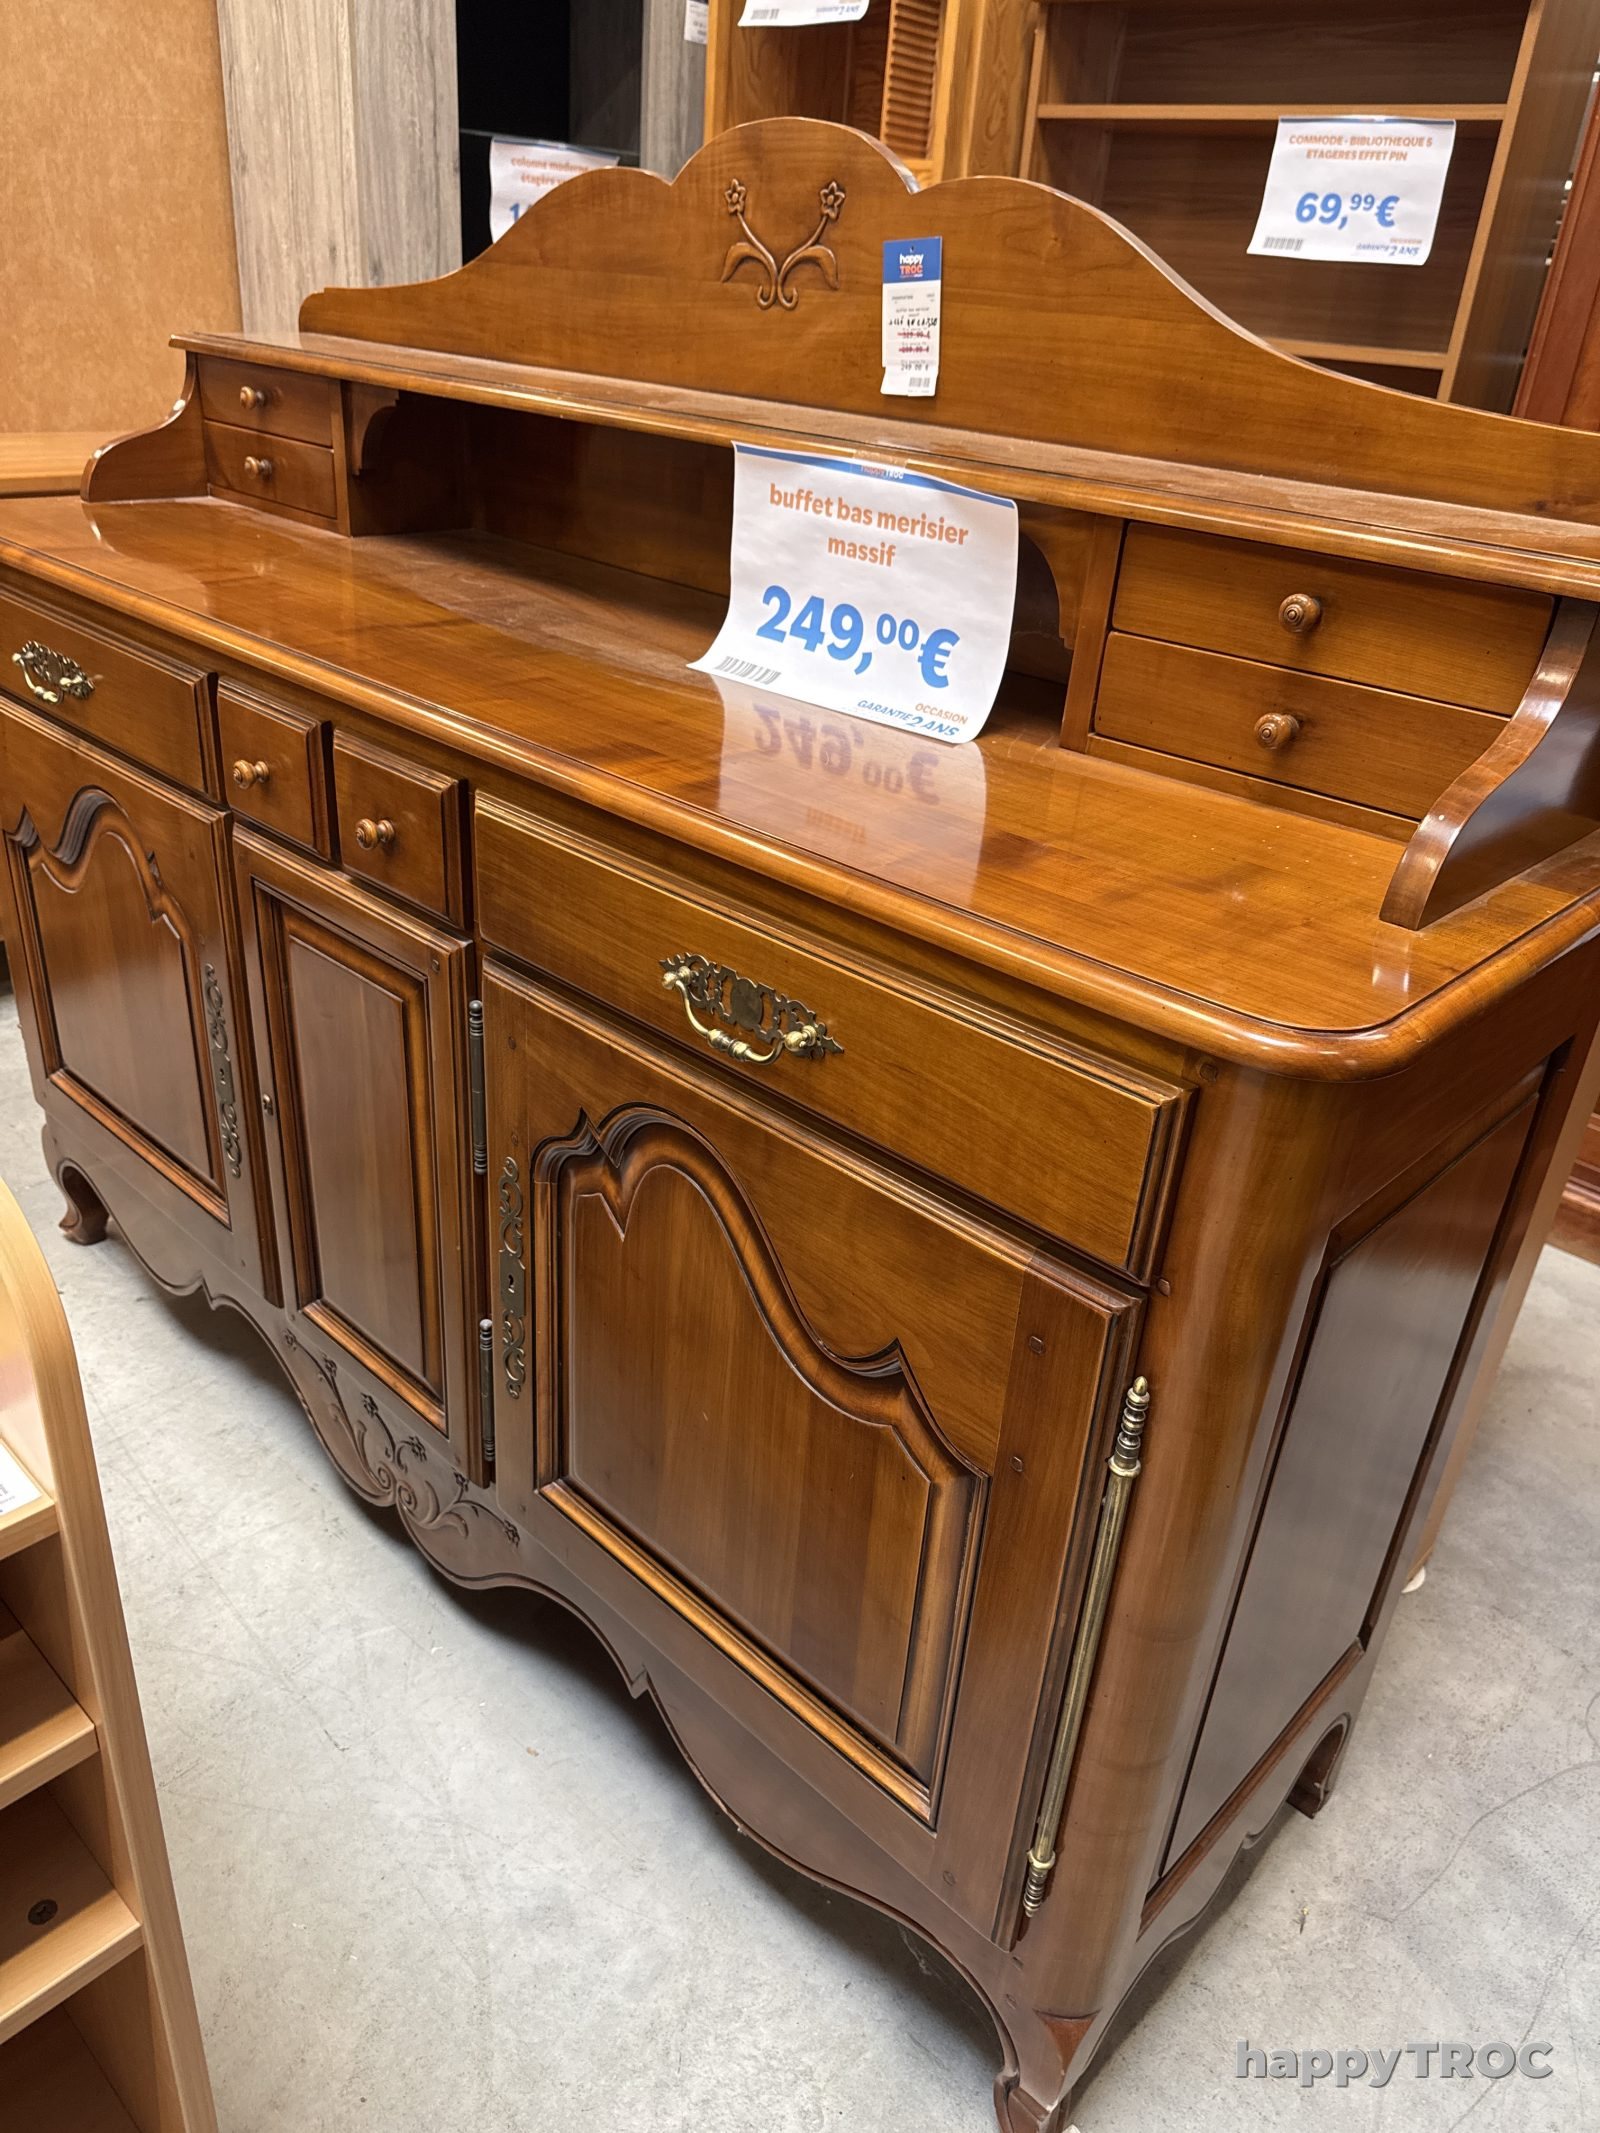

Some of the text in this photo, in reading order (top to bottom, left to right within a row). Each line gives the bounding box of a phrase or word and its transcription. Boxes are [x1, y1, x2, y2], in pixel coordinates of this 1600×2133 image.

[1289, 134, 1343, 146] COMMODE
[1349, 135, 1424, 147] BIBLIOTHEQUE
[1306, 149, 1408, 161] ETAGERES EFFET PIN
[899, 253, 924, 265] happy
[900, 265, 923, 275] TROC
[769, 483, 969, 545] buffet bas merisier
[828, 536, 896, 567] massif
[857, 699, 960, 736] GARANTIE 2 ANS
[915, 703, 968, 725] OCCASION
